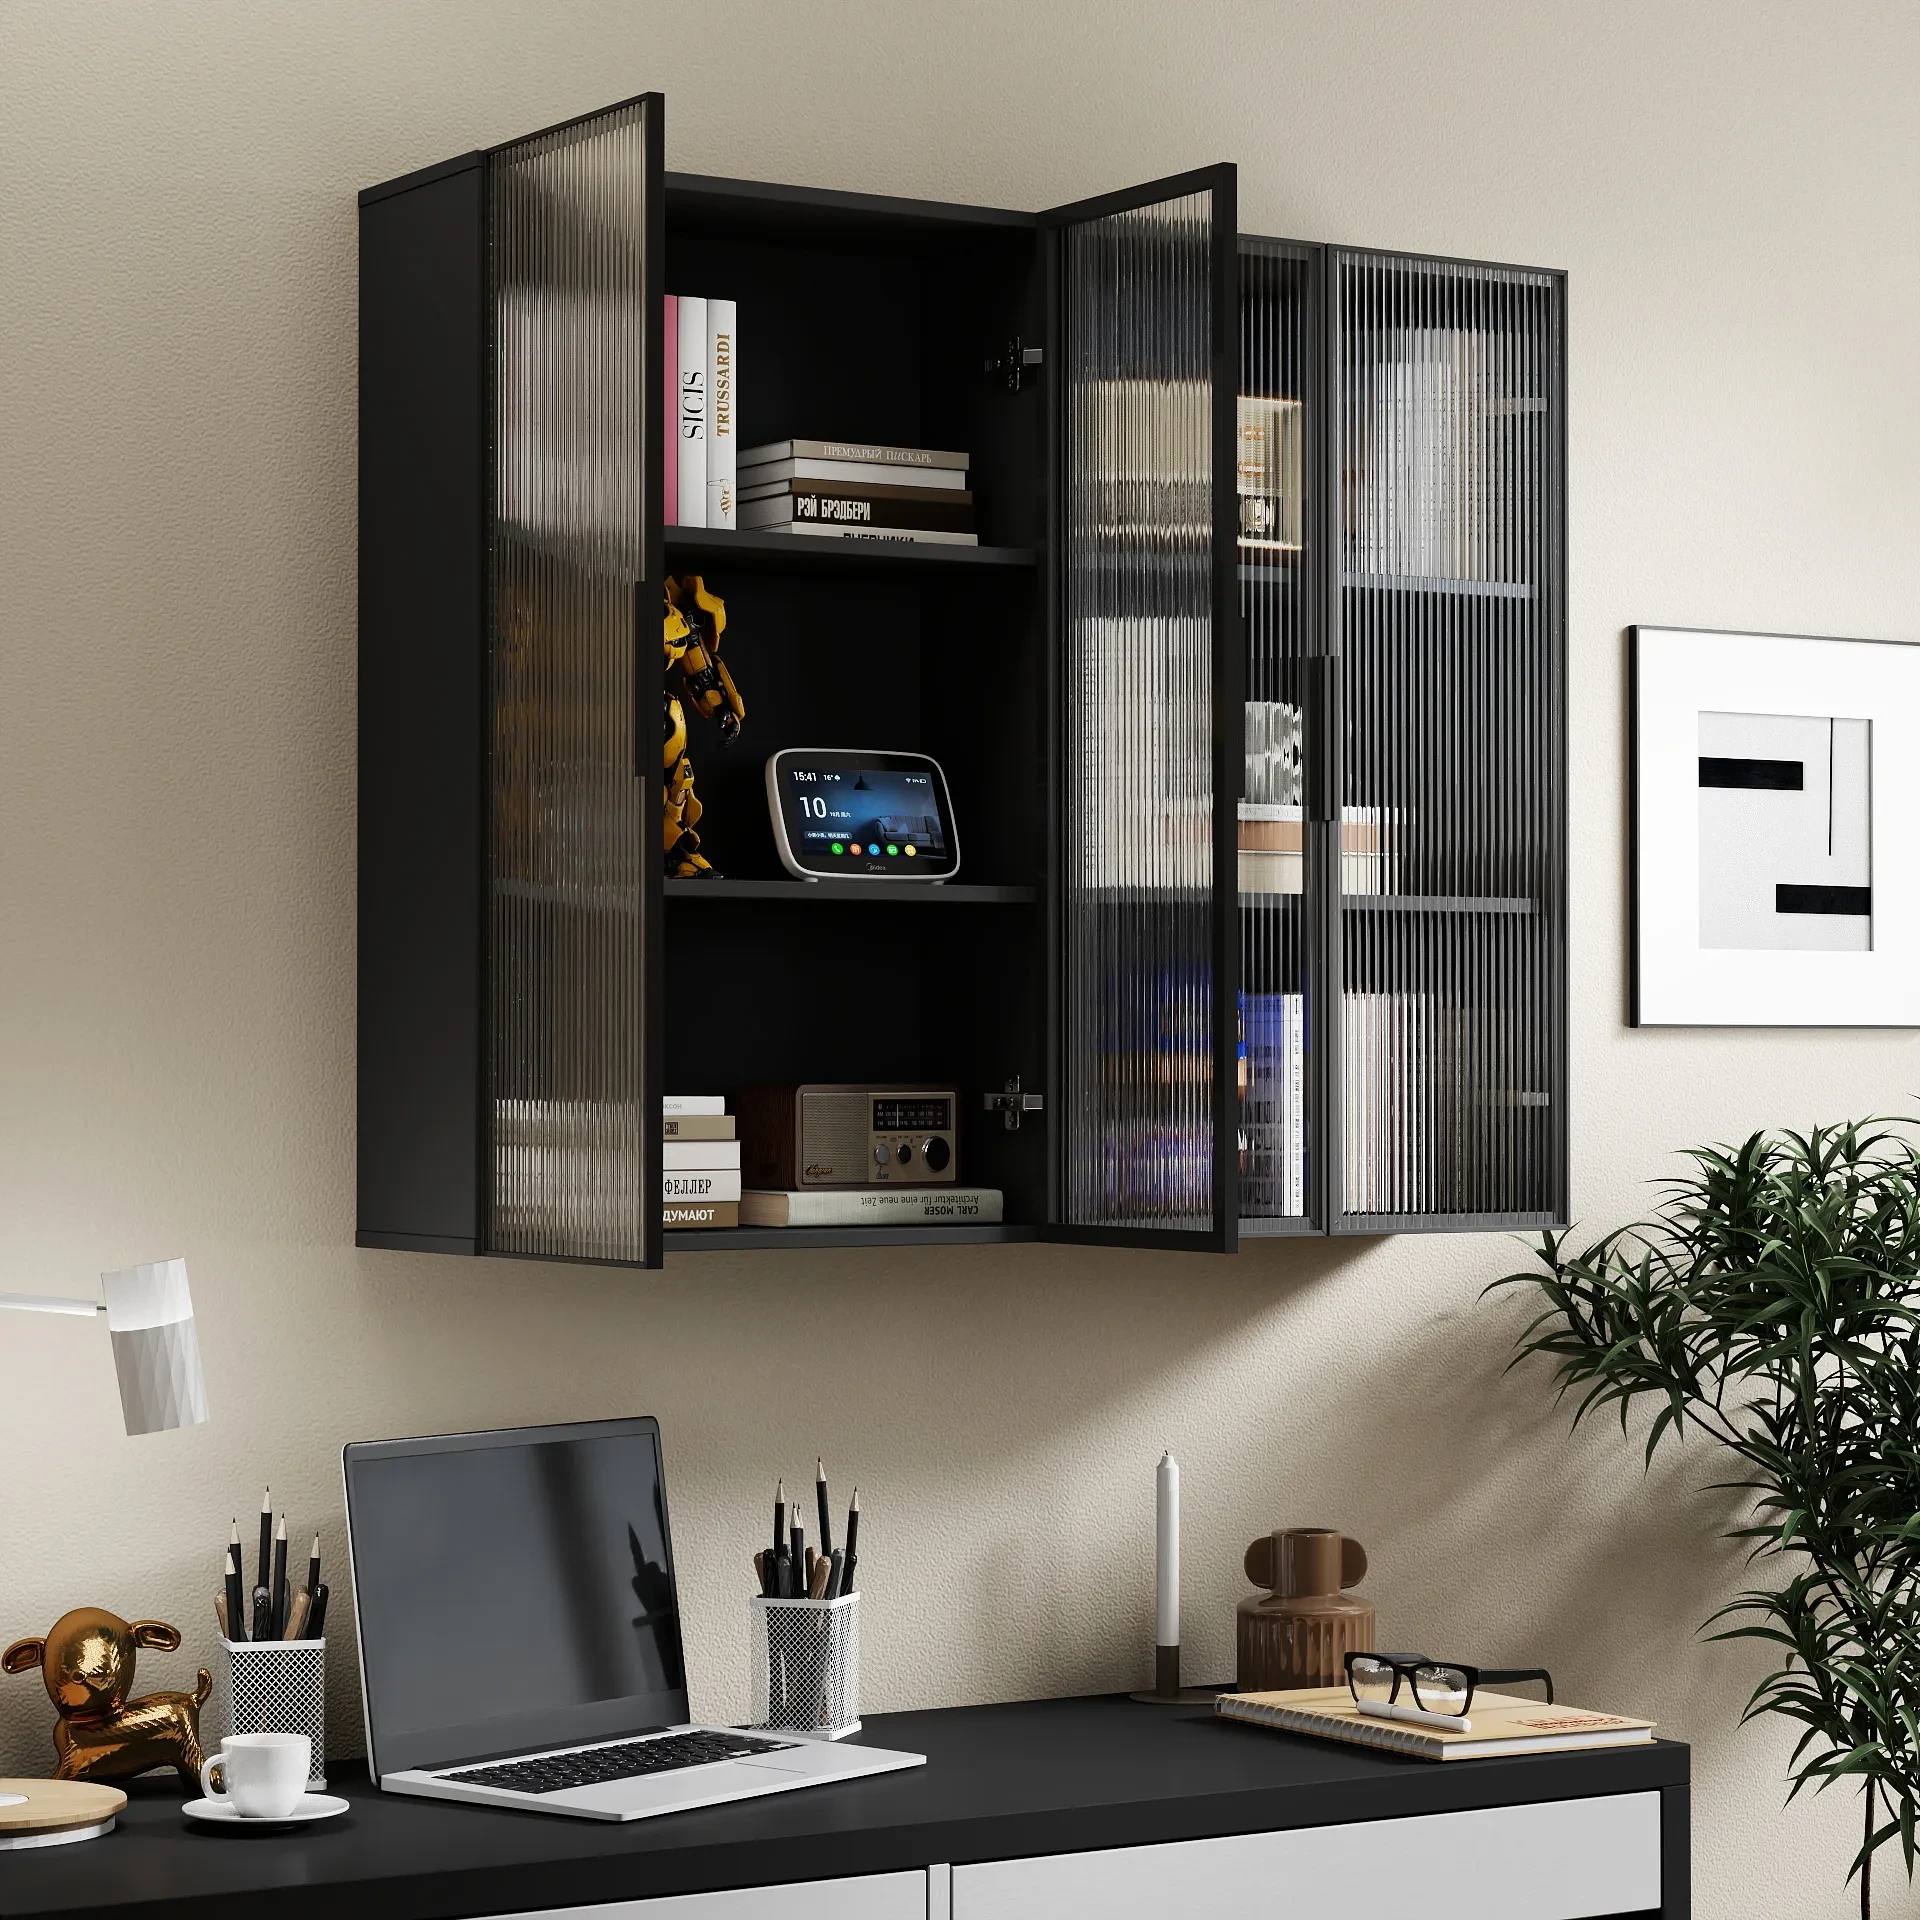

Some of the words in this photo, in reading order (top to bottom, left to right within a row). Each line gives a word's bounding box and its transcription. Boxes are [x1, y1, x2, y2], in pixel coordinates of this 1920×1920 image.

[717, 333, 730, 437] TRUSSARDI
[682, 371, 705, 440] SICIS
[824, 445, 882, 460] ПРЕМУДРЫЙ
[797, 494, 817, 517] РЭЙ
[821, 498, 871, 521] БРЭДБЕРИ
[793, 771, 817, 782] 15:41
[799, 796, 827, 819] 10
[664, 1179, 712, 1195] ФЕЛЛЕР
[861, 1197, 877, 1207] Zeit
[879, 1196, 899, 1204] neue
[900, 1196, 918, 1206] eine
[920, 1195, 932, 1205] für
[934, 1195, 979, 1205] Architektur
[924, 1206, 954, 1215] MOSER
[956, 1205, 979, 1215] CARL
[663, 1210, 715, 1223] ДУМАЮТ
